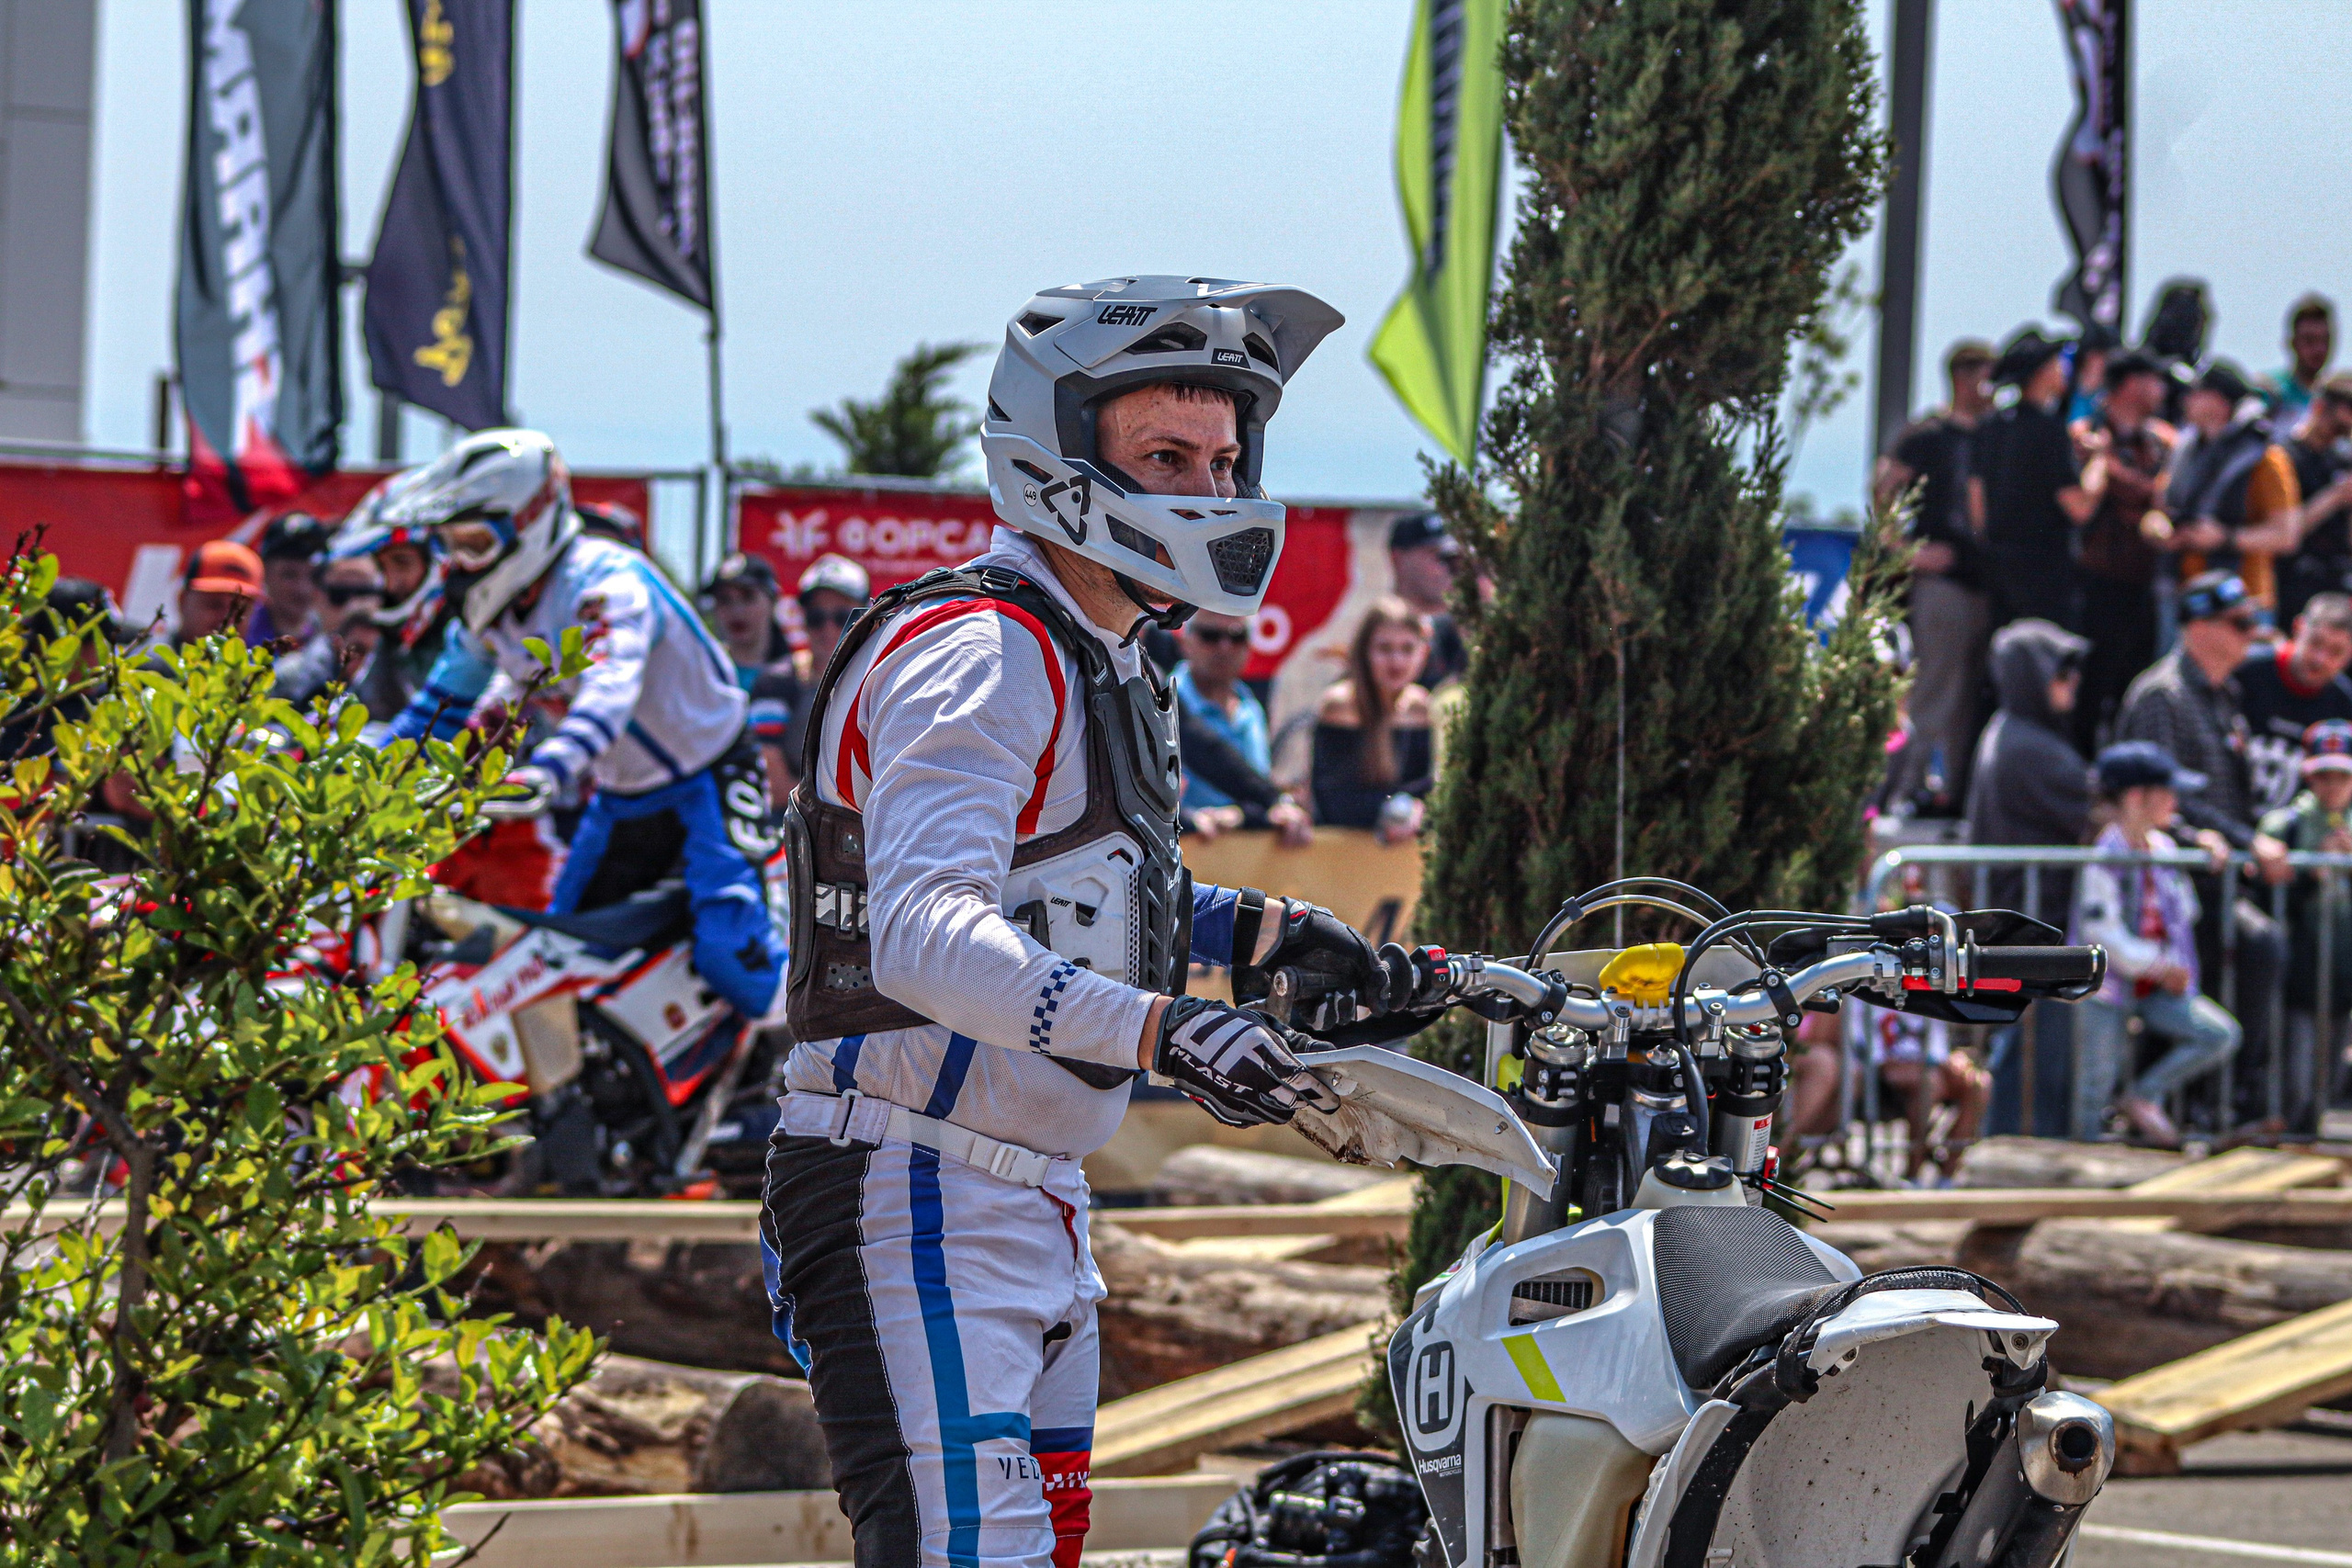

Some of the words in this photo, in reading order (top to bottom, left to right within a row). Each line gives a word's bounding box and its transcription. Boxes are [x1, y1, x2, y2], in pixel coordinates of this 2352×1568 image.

[1097, 304, 1158, 327] LEATT
[1217, 351, 1243, 364] LEATT
[1024, 489, 1037, 501] 449
[1050, 897, 1073, 908] LEATT
[1418, 1454, 1462, 1474] Husqvarna
